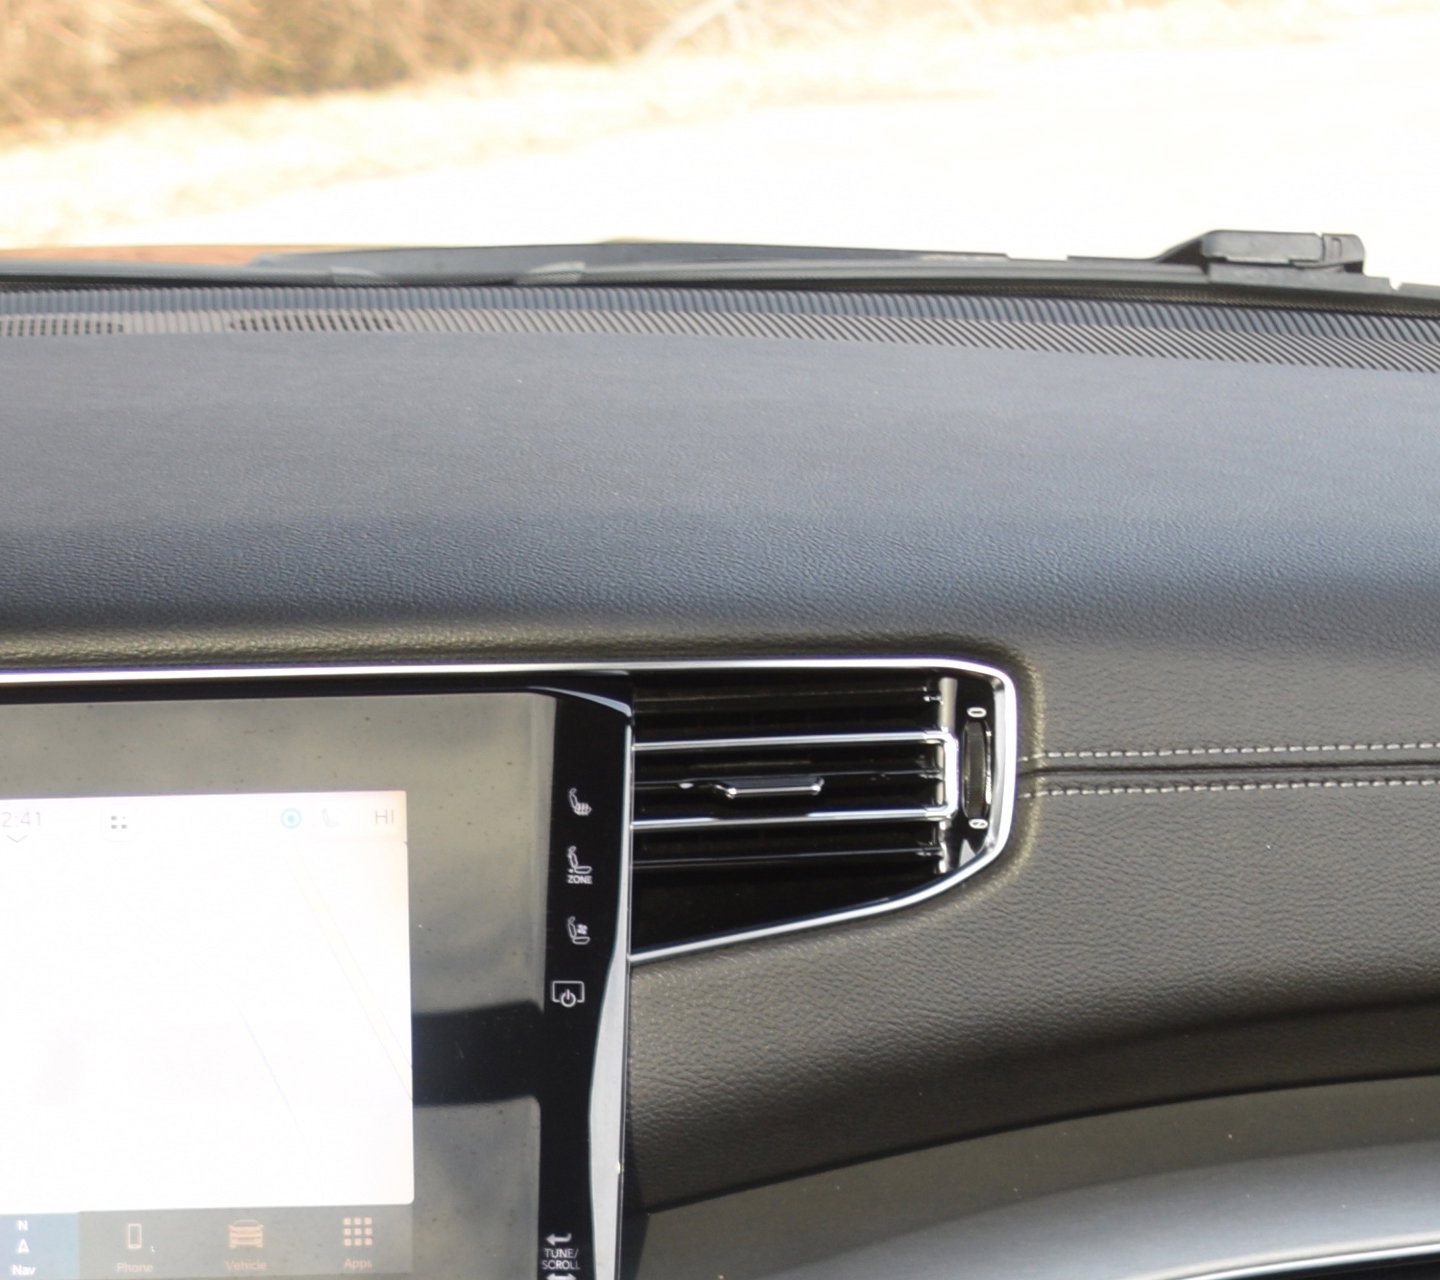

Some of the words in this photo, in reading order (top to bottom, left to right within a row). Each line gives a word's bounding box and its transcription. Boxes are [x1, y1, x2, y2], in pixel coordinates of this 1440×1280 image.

[374, 809, 395, 825] HI
[567, 875, 593, 885] ZONE
[544, 1248, 579, 1259] TUNE/
[10, 1264, 36, 1276] Nav
[116, 1262, 154, 1273] Phone
[224, 1260, 268, 1271] Vehicle
[542, 1260, 581, 1270] SCROLL
